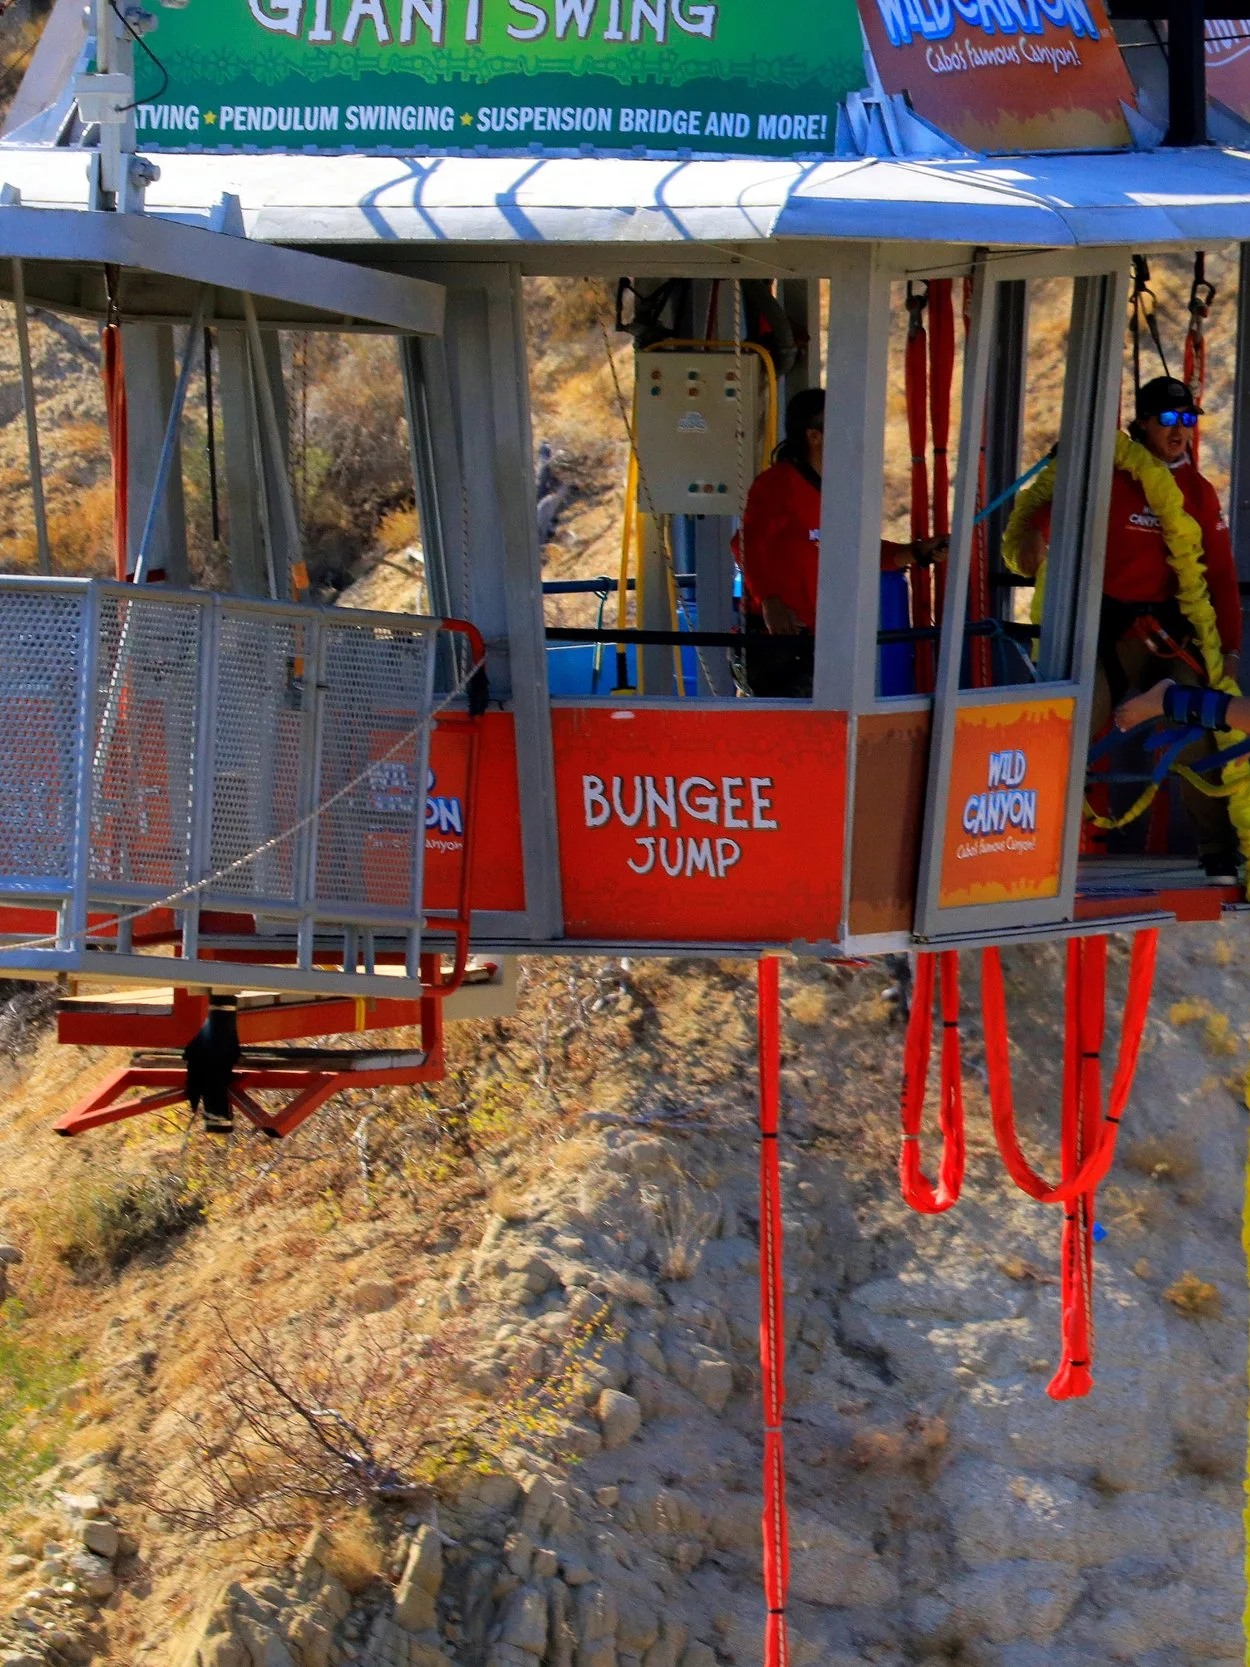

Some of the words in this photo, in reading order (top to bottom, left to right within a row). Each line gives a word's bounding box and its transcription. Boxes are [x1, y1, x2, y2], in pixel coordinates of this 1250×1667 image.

[506, 0, 718, 42] SWING
[219, 105, 339, 131] PENDULUM
[344, 105, 455, 132] SWINGING
[476, 106, 613, 133] SUSPENSION
[619, 107, 701, 137] BRIDGE
[704, 111, 750, 138] AND
[757, 113, 828, 140] MORE!
[987, 749, 1027, 791] WILD
[582, 774, 780, 830] BUNGEE
[962, 788, 1037, 838] CANYON
[626, 836, 742, 878] JUMP
